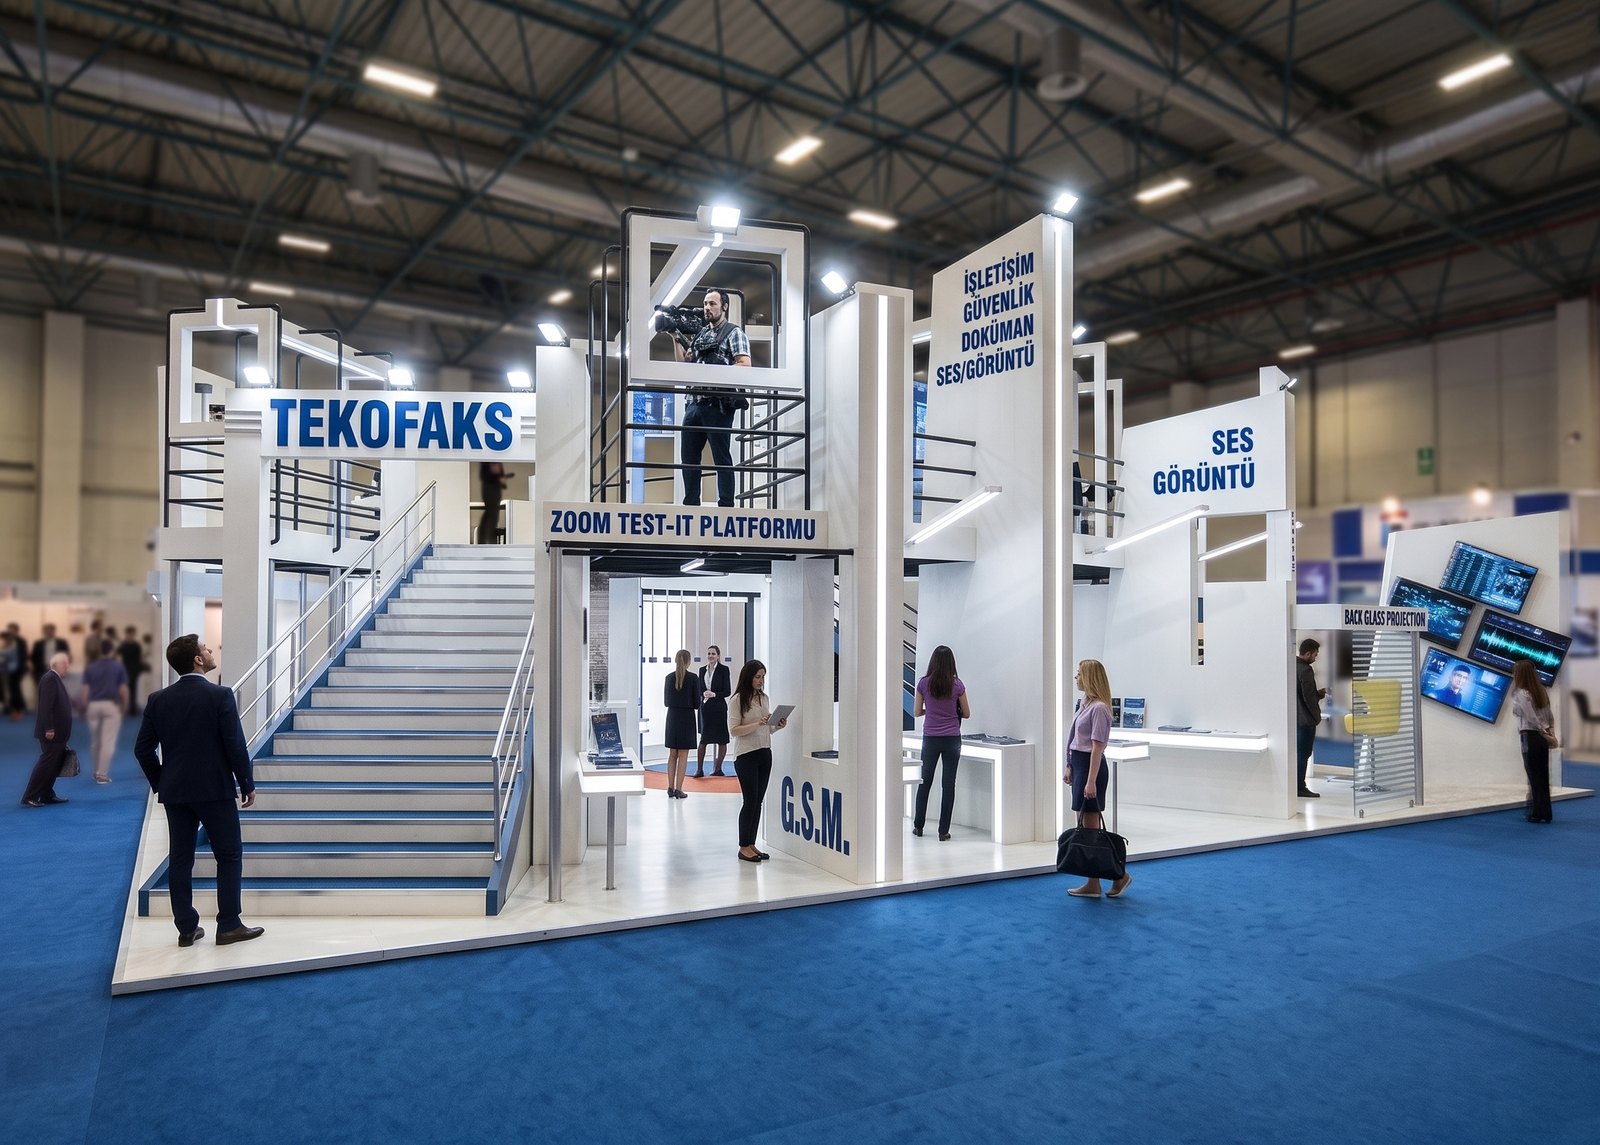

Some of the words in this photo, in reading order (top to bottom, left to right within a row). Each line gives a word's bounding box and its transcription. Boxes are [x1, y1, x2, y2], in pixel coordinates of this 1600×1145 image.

[964, 251, 1034, 298] İŞLETİŞİM
[963, 281, 1035, 324] GÜVENLİK
[961, 313, 1034, 353] DOKÜMAN
[936, 339, 1035, 387] SES/GÖRÜNTÜ
[270, 398, 513, 452] TEKOFAKS
[1212, 426, 1254, 456] SES
[1153, 457, 1255, 495] GÖRÜNTÜ
[550, 510, 611, 534] ZOOM
[617, 512, 694, 537] TEST-IT
[699, 515, 816, 541] PLATFORMU
[1344, 608, 1363, 626] BACK
[1364, 609, 1386, 626] GLASS
[1386, 610, 1426, 627] PROJECTION
[781, 775, 850, 857] G.S.M.
